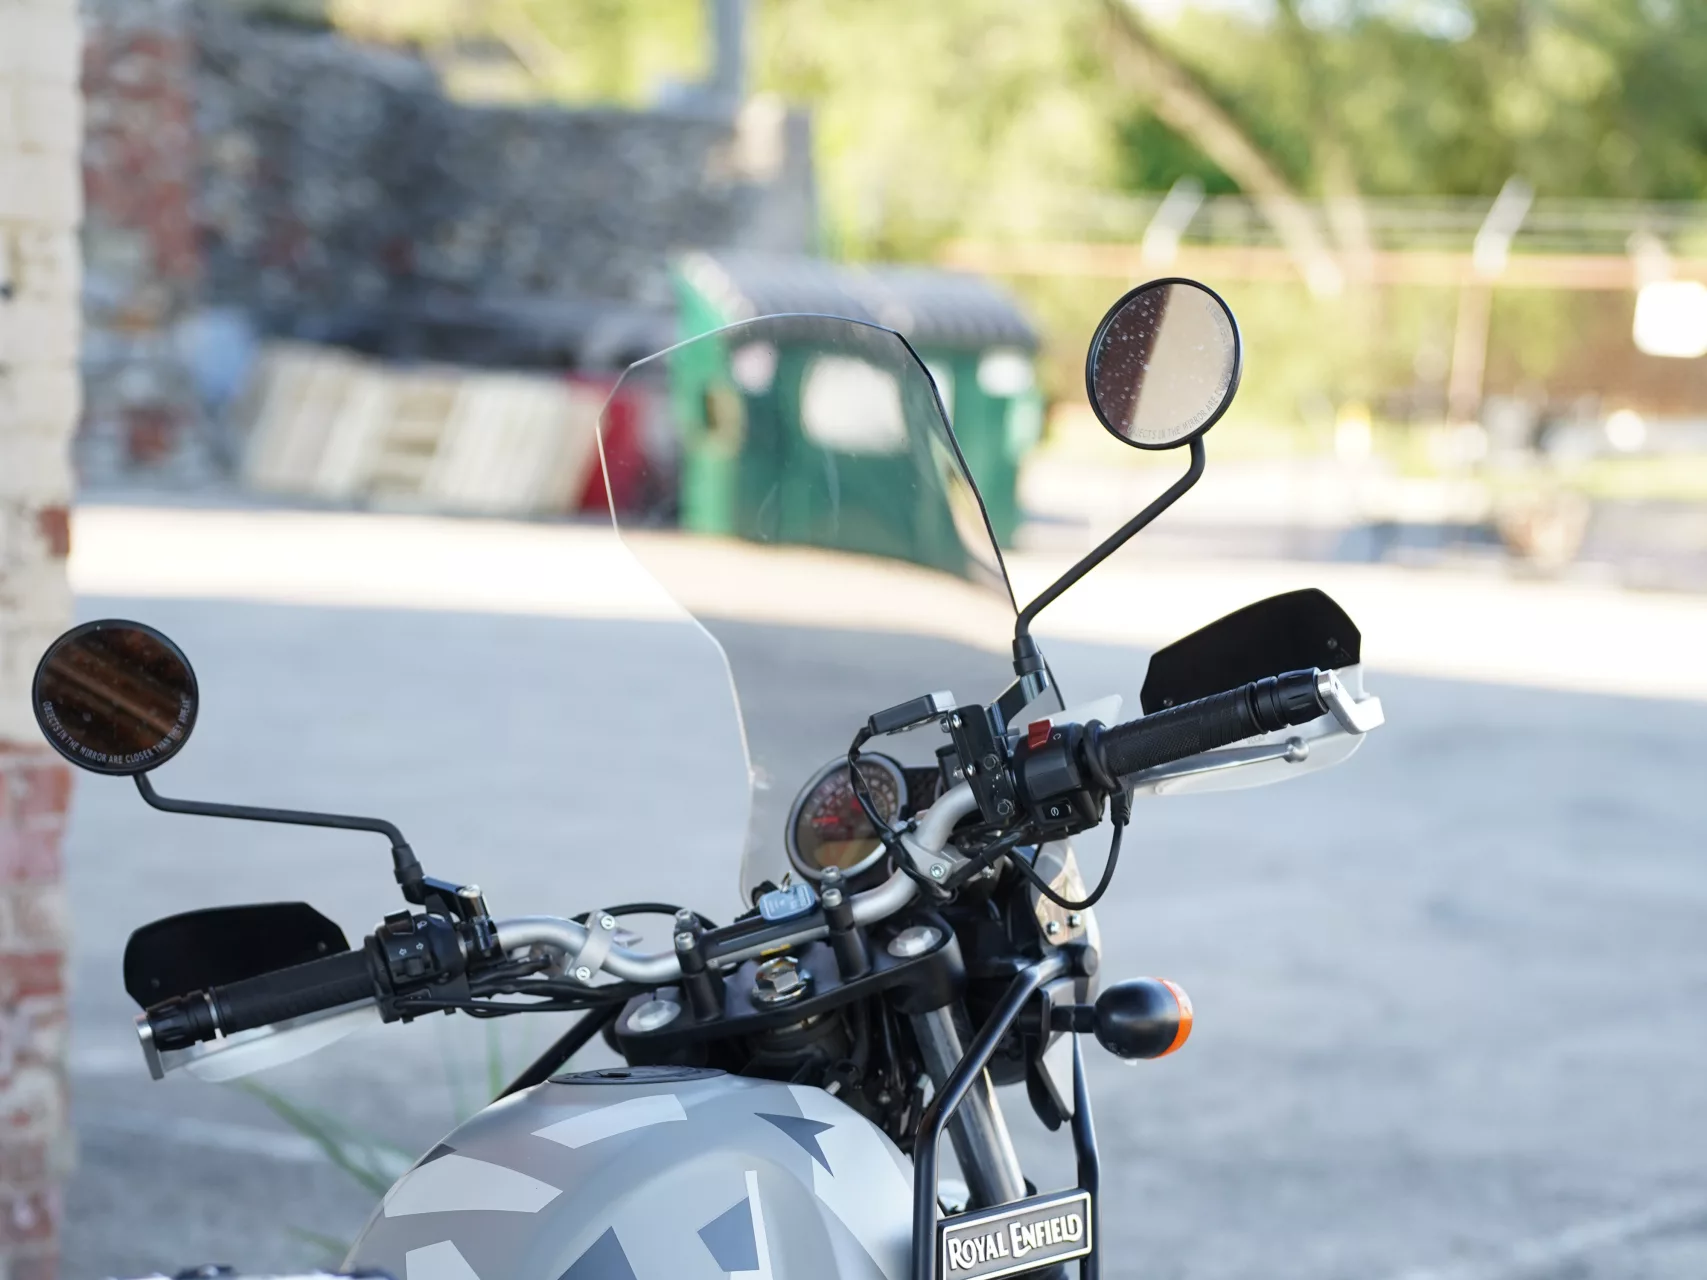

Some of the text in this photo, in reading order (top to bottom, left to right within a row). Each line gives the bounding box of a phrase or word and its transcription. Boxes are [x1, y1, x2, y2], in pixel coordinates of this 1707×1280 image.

[1167, 425, 1180, 437] THE
[1182, 409, 1207, 430] MIRROR
[1205, 396, 1219, 412] ARE
[43, 700, 62, 733] OBJECTS
[56, 729, 69, 741] IN
[64, 735, 80, 751] THE
[80, 745, 107, 763] MIRROR
[108, 754, 123, 764] ARE
[125, 748, 154, 763] CLOSER
[947, 1213, 1083, 1270] ROYAL ENFIELD
